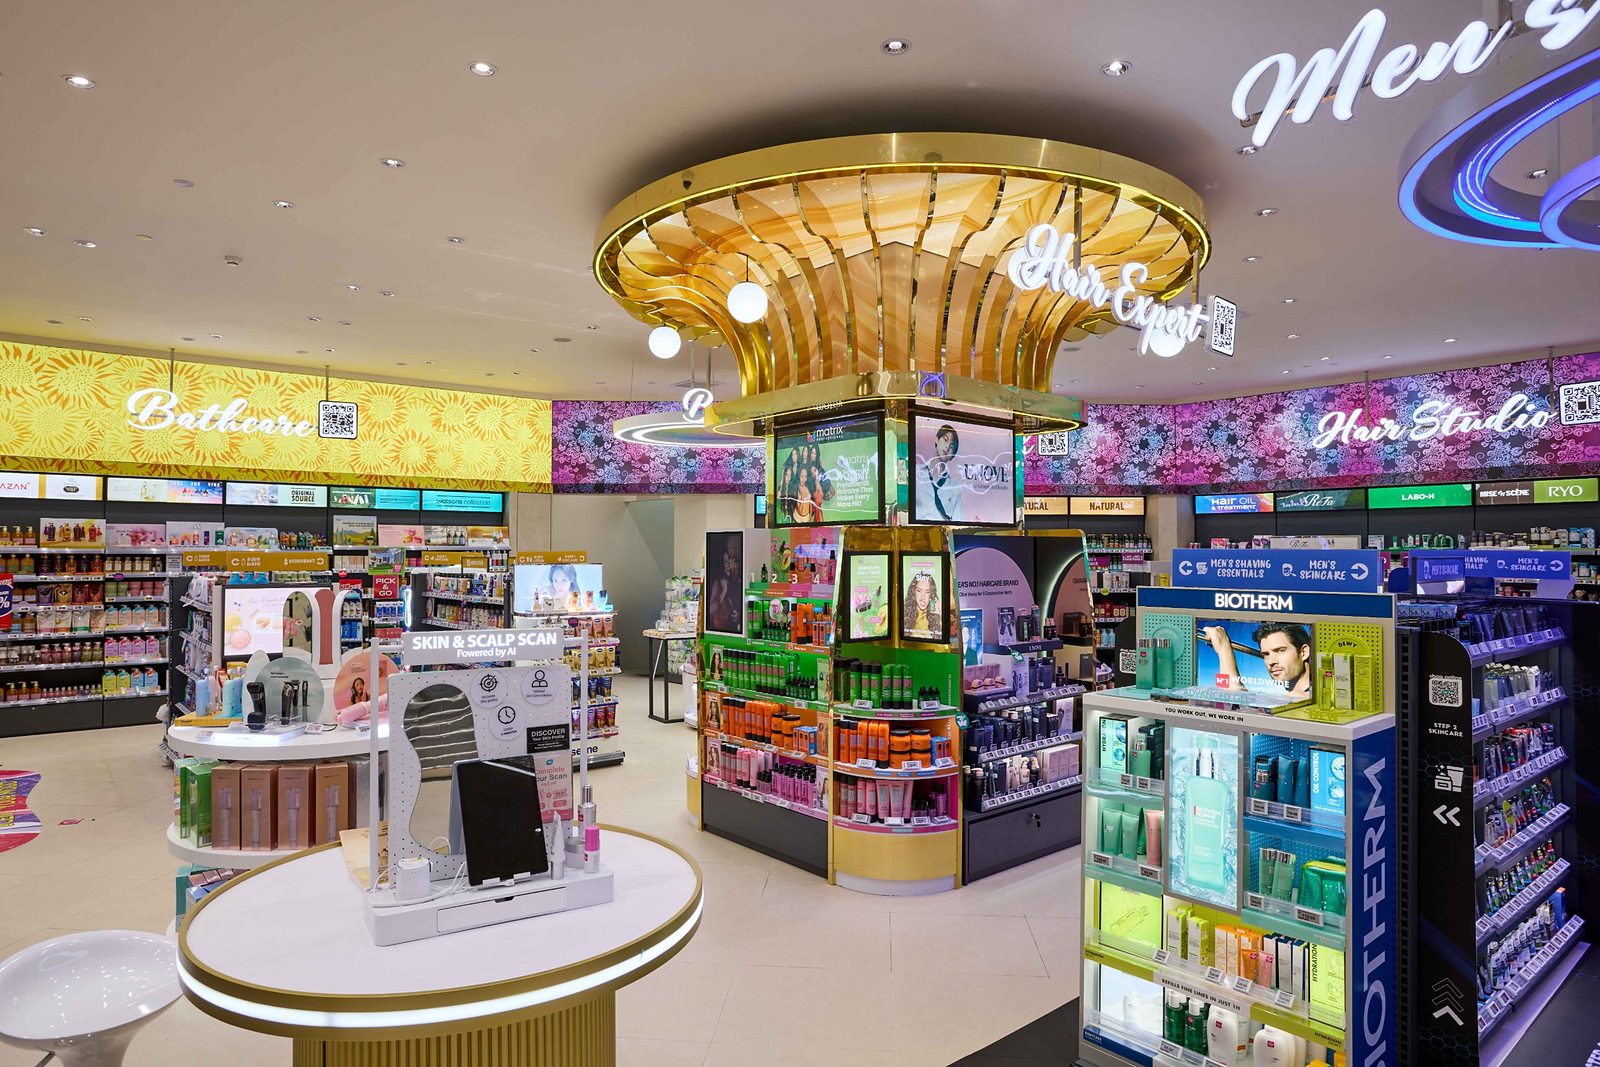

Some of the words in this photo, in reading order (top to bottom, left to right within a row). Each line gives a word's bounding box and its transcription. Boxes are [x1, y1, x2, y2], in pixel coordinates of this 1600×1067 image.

[1018, 223, 1110, 309] Hair
[1110, 262, 1211, 356] Expert
[126, 388, 318, 438] Bathcare
[1312, 408, 1405, 449] Hair
[1409, 394, 1558, 441] Studio
[816, 425, 843, 437] matrix
[964, 463, 1009, 482] UNOVE
[836, 487, 860, 495] Haircare
[860, 485, 874, 493] That
[1480, 490, 1498, 498] MISE
[1548, 485, 1583, 497] RYO
[836, 494, 855, 502] Makes
[855, 493, 871, 501] Every
[1238, 497, 1257, 505] OIL
[1089, 502, 1125, 511] NATURAL
[1211, 559, 1234, 568] MEN'S
[1235, 559, 1271, 569] SHAVING
[1309, 560, 1336, 569] MEN'S
[1464, 556, 1489, 564] HAVING
[1518, 557, 1539, 565] MEN'S
[1217, 568, 1265, 578] ESSENTIALS
[1510, 564, 1547, 572] SKINCARE
[771, 574, 778, 583] 2
[792, 574, 798, 584] 3
[813, 574, 820, 585] 4
[1299, 570, 1346, 580] SKINCARE
[1003, 579, 1019, 587] BRAND
[1214, 593, 1293, 611] BIOTHERM
[412, 635, 449, 650] SKIN
[453, 635, 464, 648] &
[467, 633, 515, 648] SCALP
[518, 632, 557, 646] SCAN
[457, 647, 494, 658] Powered
[495, 648, 506, 657] by
[1230, 676, 1290, 688] WORLDWIDE
[1218, 714, 1236, 722] WORK
[531, 728, 566, 738] DISCOVER
[1428, 728, 1464, 738] SKINCARE
[549, 773, 568, 781] Scan
[1363, 757, 1387, 1067] IOTHERM
[1161, 978, 1180, 989] REFILLS
[1180, 984, 1193, 994] FINE
[1193, 988, 1209, 1000] LINES
[1217, 996, 1232, 1007] JUST
[1314, 1032, 1342, 1045] HYDRATION
